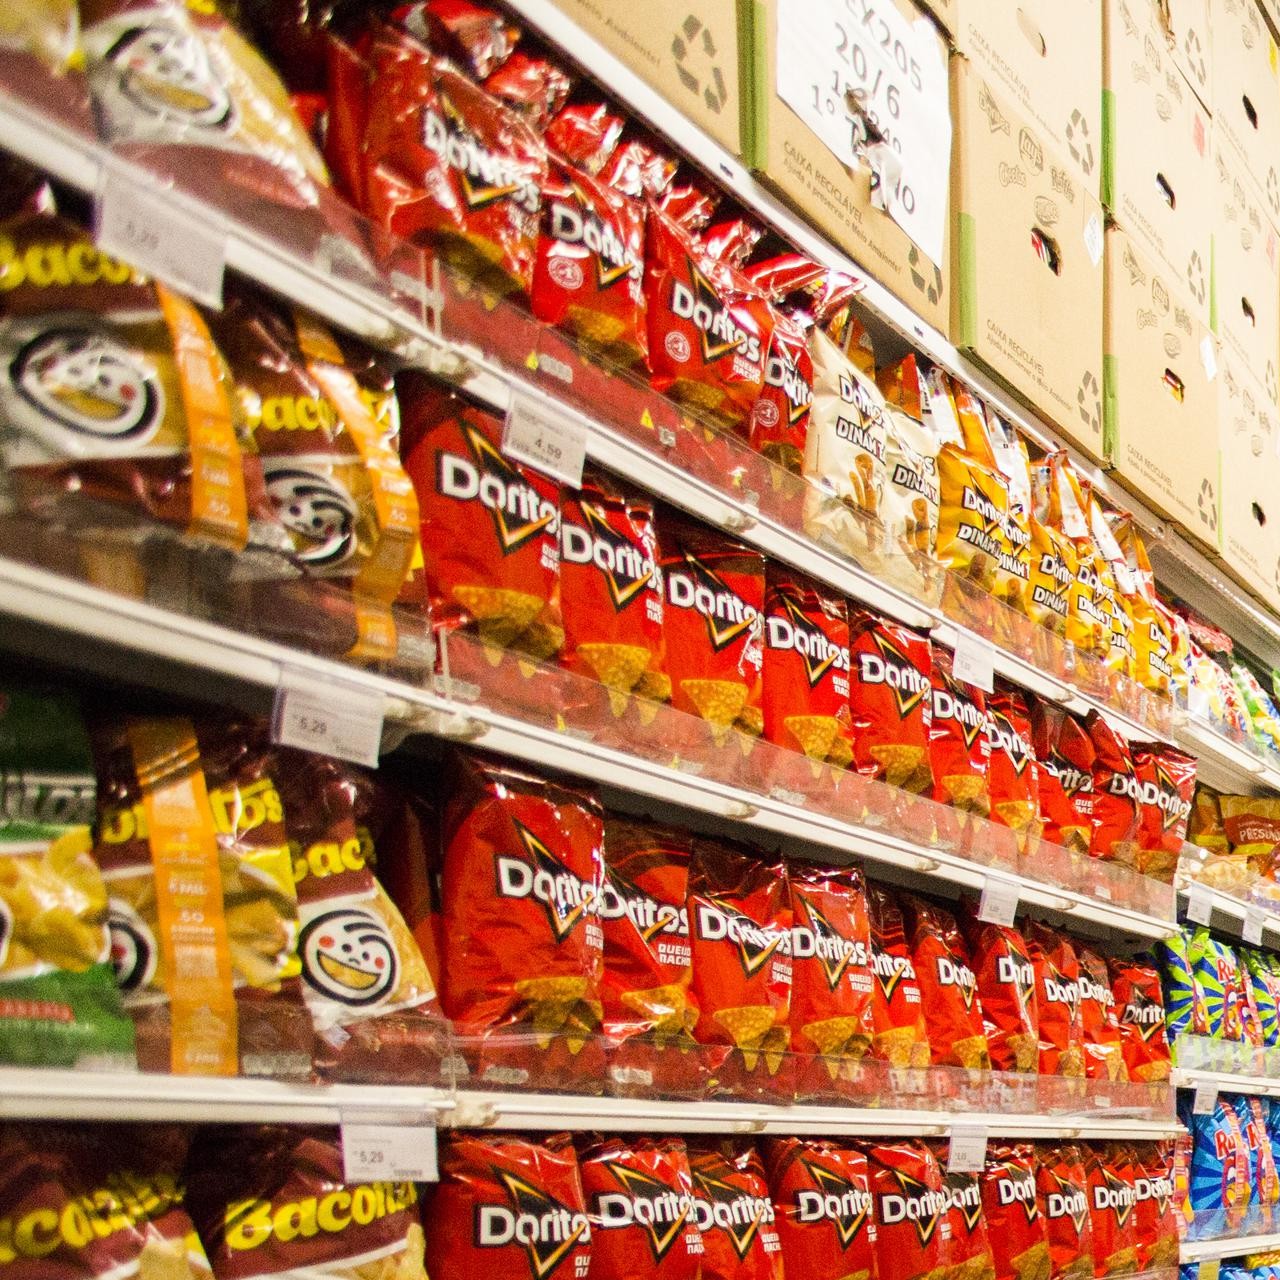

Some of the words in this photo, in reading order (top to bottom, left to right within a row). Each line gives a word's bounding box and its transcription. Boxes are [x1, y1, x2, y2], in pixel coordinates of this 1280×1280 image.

[784, 141, 812, 174] CAIXA
[815, 172, 864, 224] RECICLÁVEL
[672, 279, 761, 361] Doritos
[562, 521, 662, 593] Doritos
[1033, 585, 1069, 617] DINAM
[767, 616, 850, 672] Doritos
[860, 653, 931, 695] Dorito
[933, 690, 989, 731] Dorito
[699, 907, 791, 957] Doritos
[793, 927, 869, 965] Doritos
[872, 952, 916, 979] oritos
[938, 957, 976, 990] Dorit
[999, 957, 1034, 988] Dori
[1122, 1003, 1165, 1025] Dorit
[799, 1191, 873, 1223] Dorito
[943, 1184, 980, 1209] Dori
[999, 1177, 1035, 1205] Dori
[1049, 1193, 1087, 1218] Dori
[1095, 1185, 1136, 1210] Dorito
[226, 1181, 416, 1251] Baconz
[695, 1196, 774, 1230] Doritos
[882, 1192, 946, 1224] Dorito
[479, 1206, 591, 1247] Dorito
